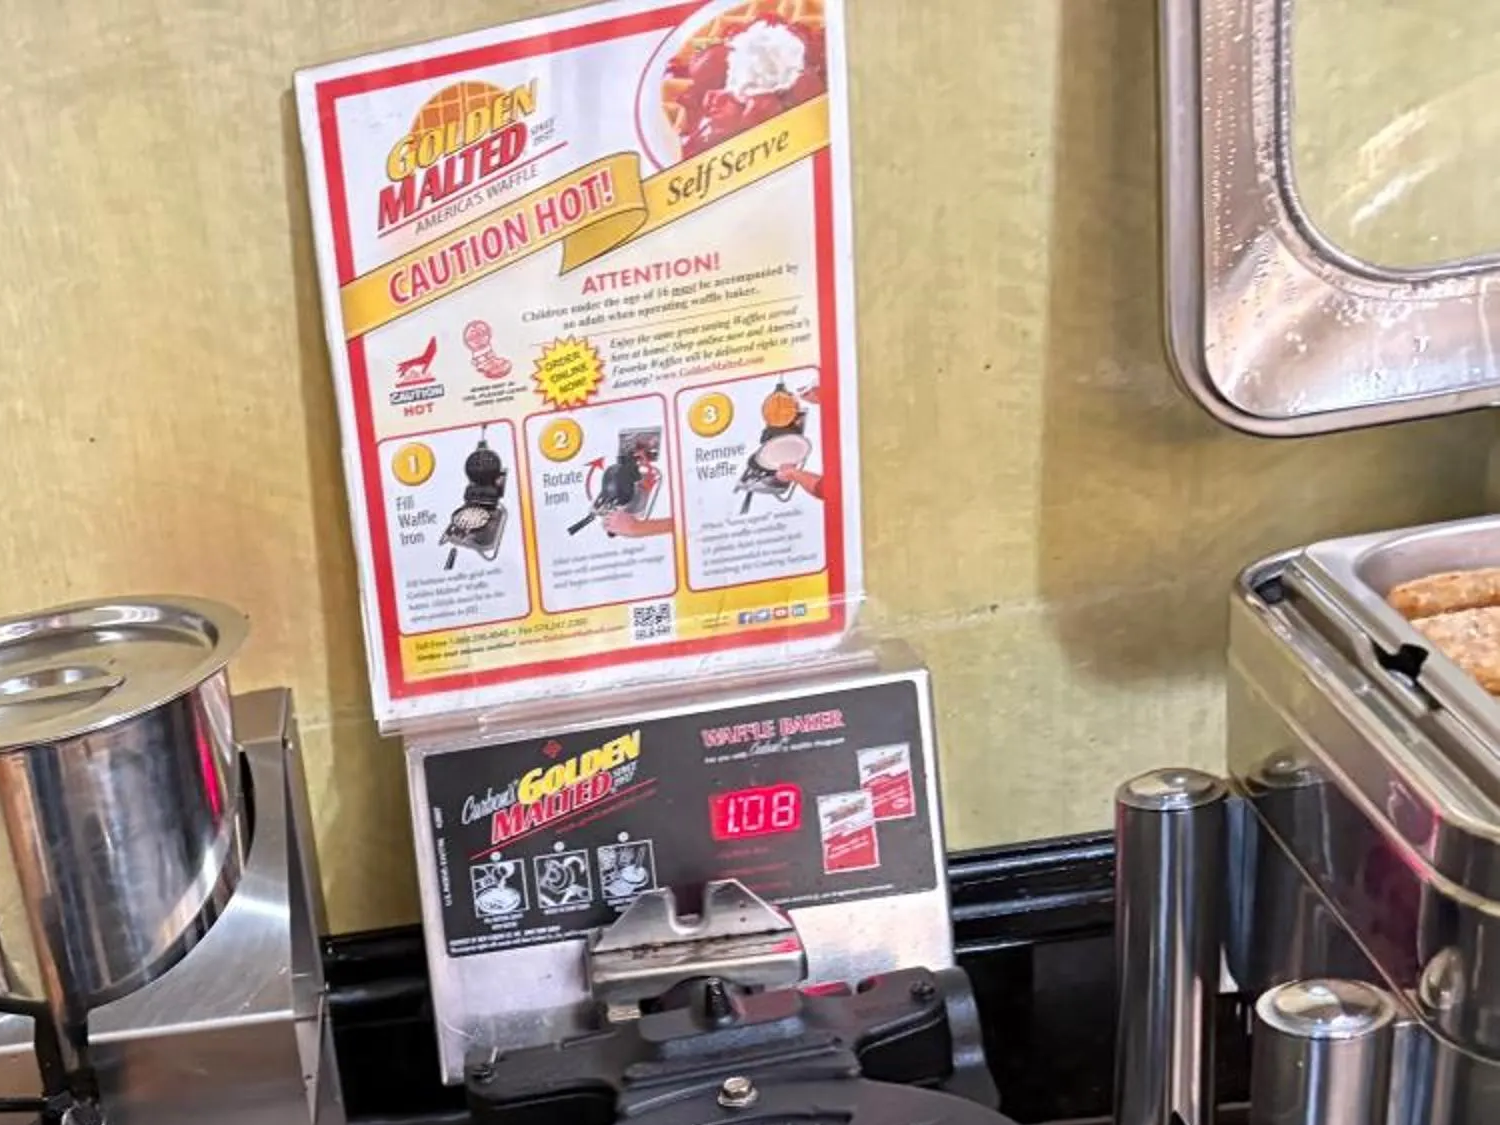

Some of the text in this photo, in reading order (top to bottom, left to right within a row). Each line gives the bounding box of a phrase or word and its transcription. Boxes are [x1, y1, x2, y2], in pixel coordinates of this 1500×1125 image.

[386, 78, 538, 182] GOLDEN
[378, 122, 528, 231] MALTED
[666, 130, 789, 206] Self Serve
[414, 164, 539, 234] AMERICA'S WAFFLE
[390, 170, 613, 304] CAUTION HOT!
[581, 251, 721, 295] ATTENTION!
[403, 403, 435, 417] HOT
[553, 430, 570, 449] 2
[696, 444, 746, 462] Remove
[543, 470, 583, 488] Rotate
[697, 463, 738, 480] Waffle
[399, 511, 437, 528] Waffle
[544, 493, 570, 506] Iron
[400, 533, 425, 546] Iron
[701, 708, 847, 748] WAFFLE BAKER
[517, 729, 641, 805] GOLDEN
[491, 771, 613, 845] MALTED
